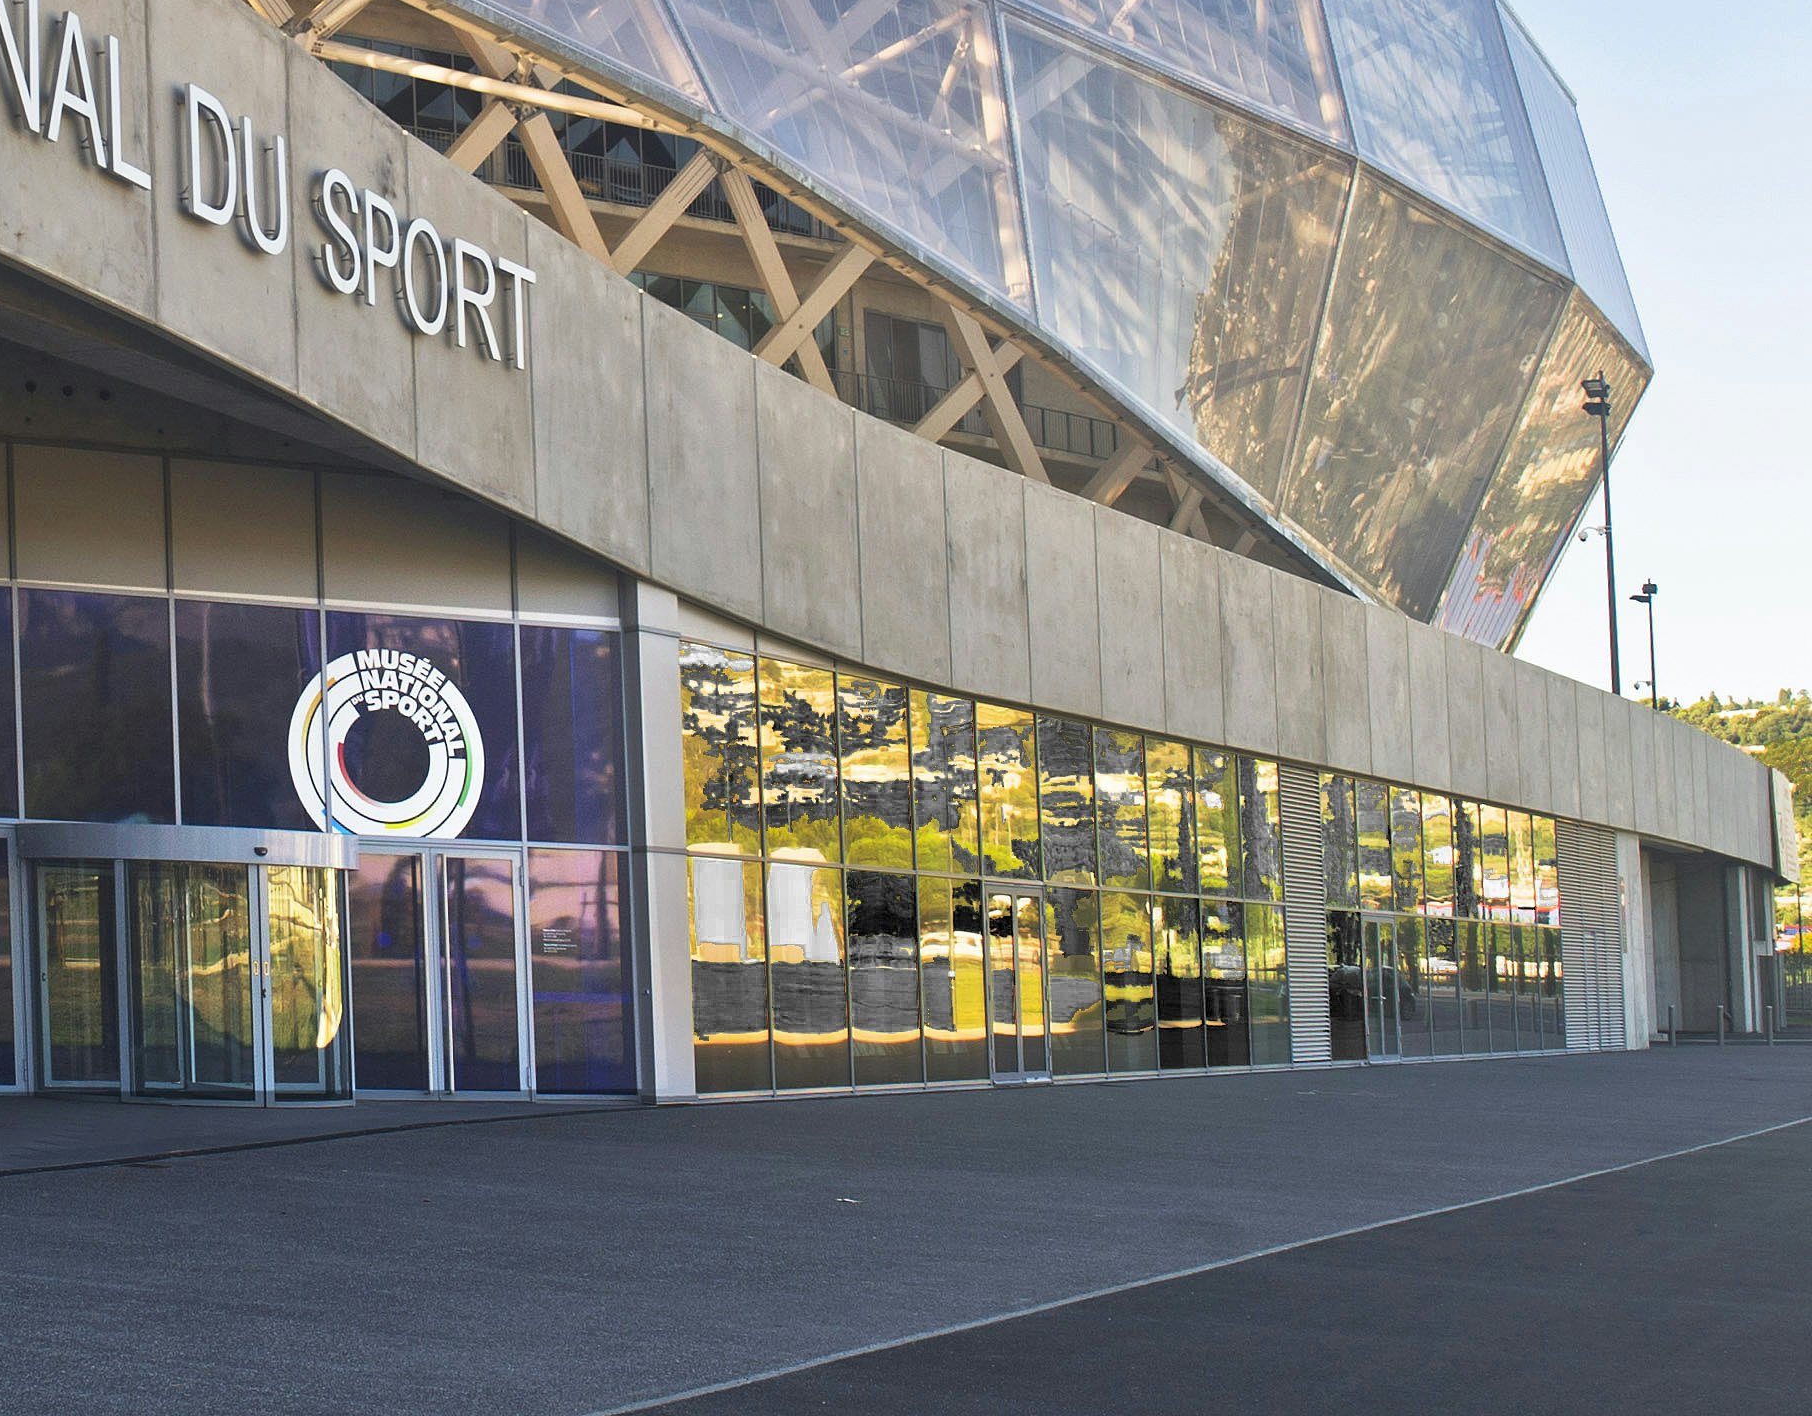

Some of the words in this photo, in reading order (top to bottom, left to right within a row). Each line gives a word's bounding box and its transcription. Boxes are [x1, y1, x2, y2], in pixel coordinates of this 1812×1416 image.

[185, 83, 288, 256] DU
[320, 169, 537, 370] SPORT
[356, 648, 446, 691] MUSÉE
[359, 669, 466, 757] NATIONAL
[364, 689, 443, 742] SPORT
